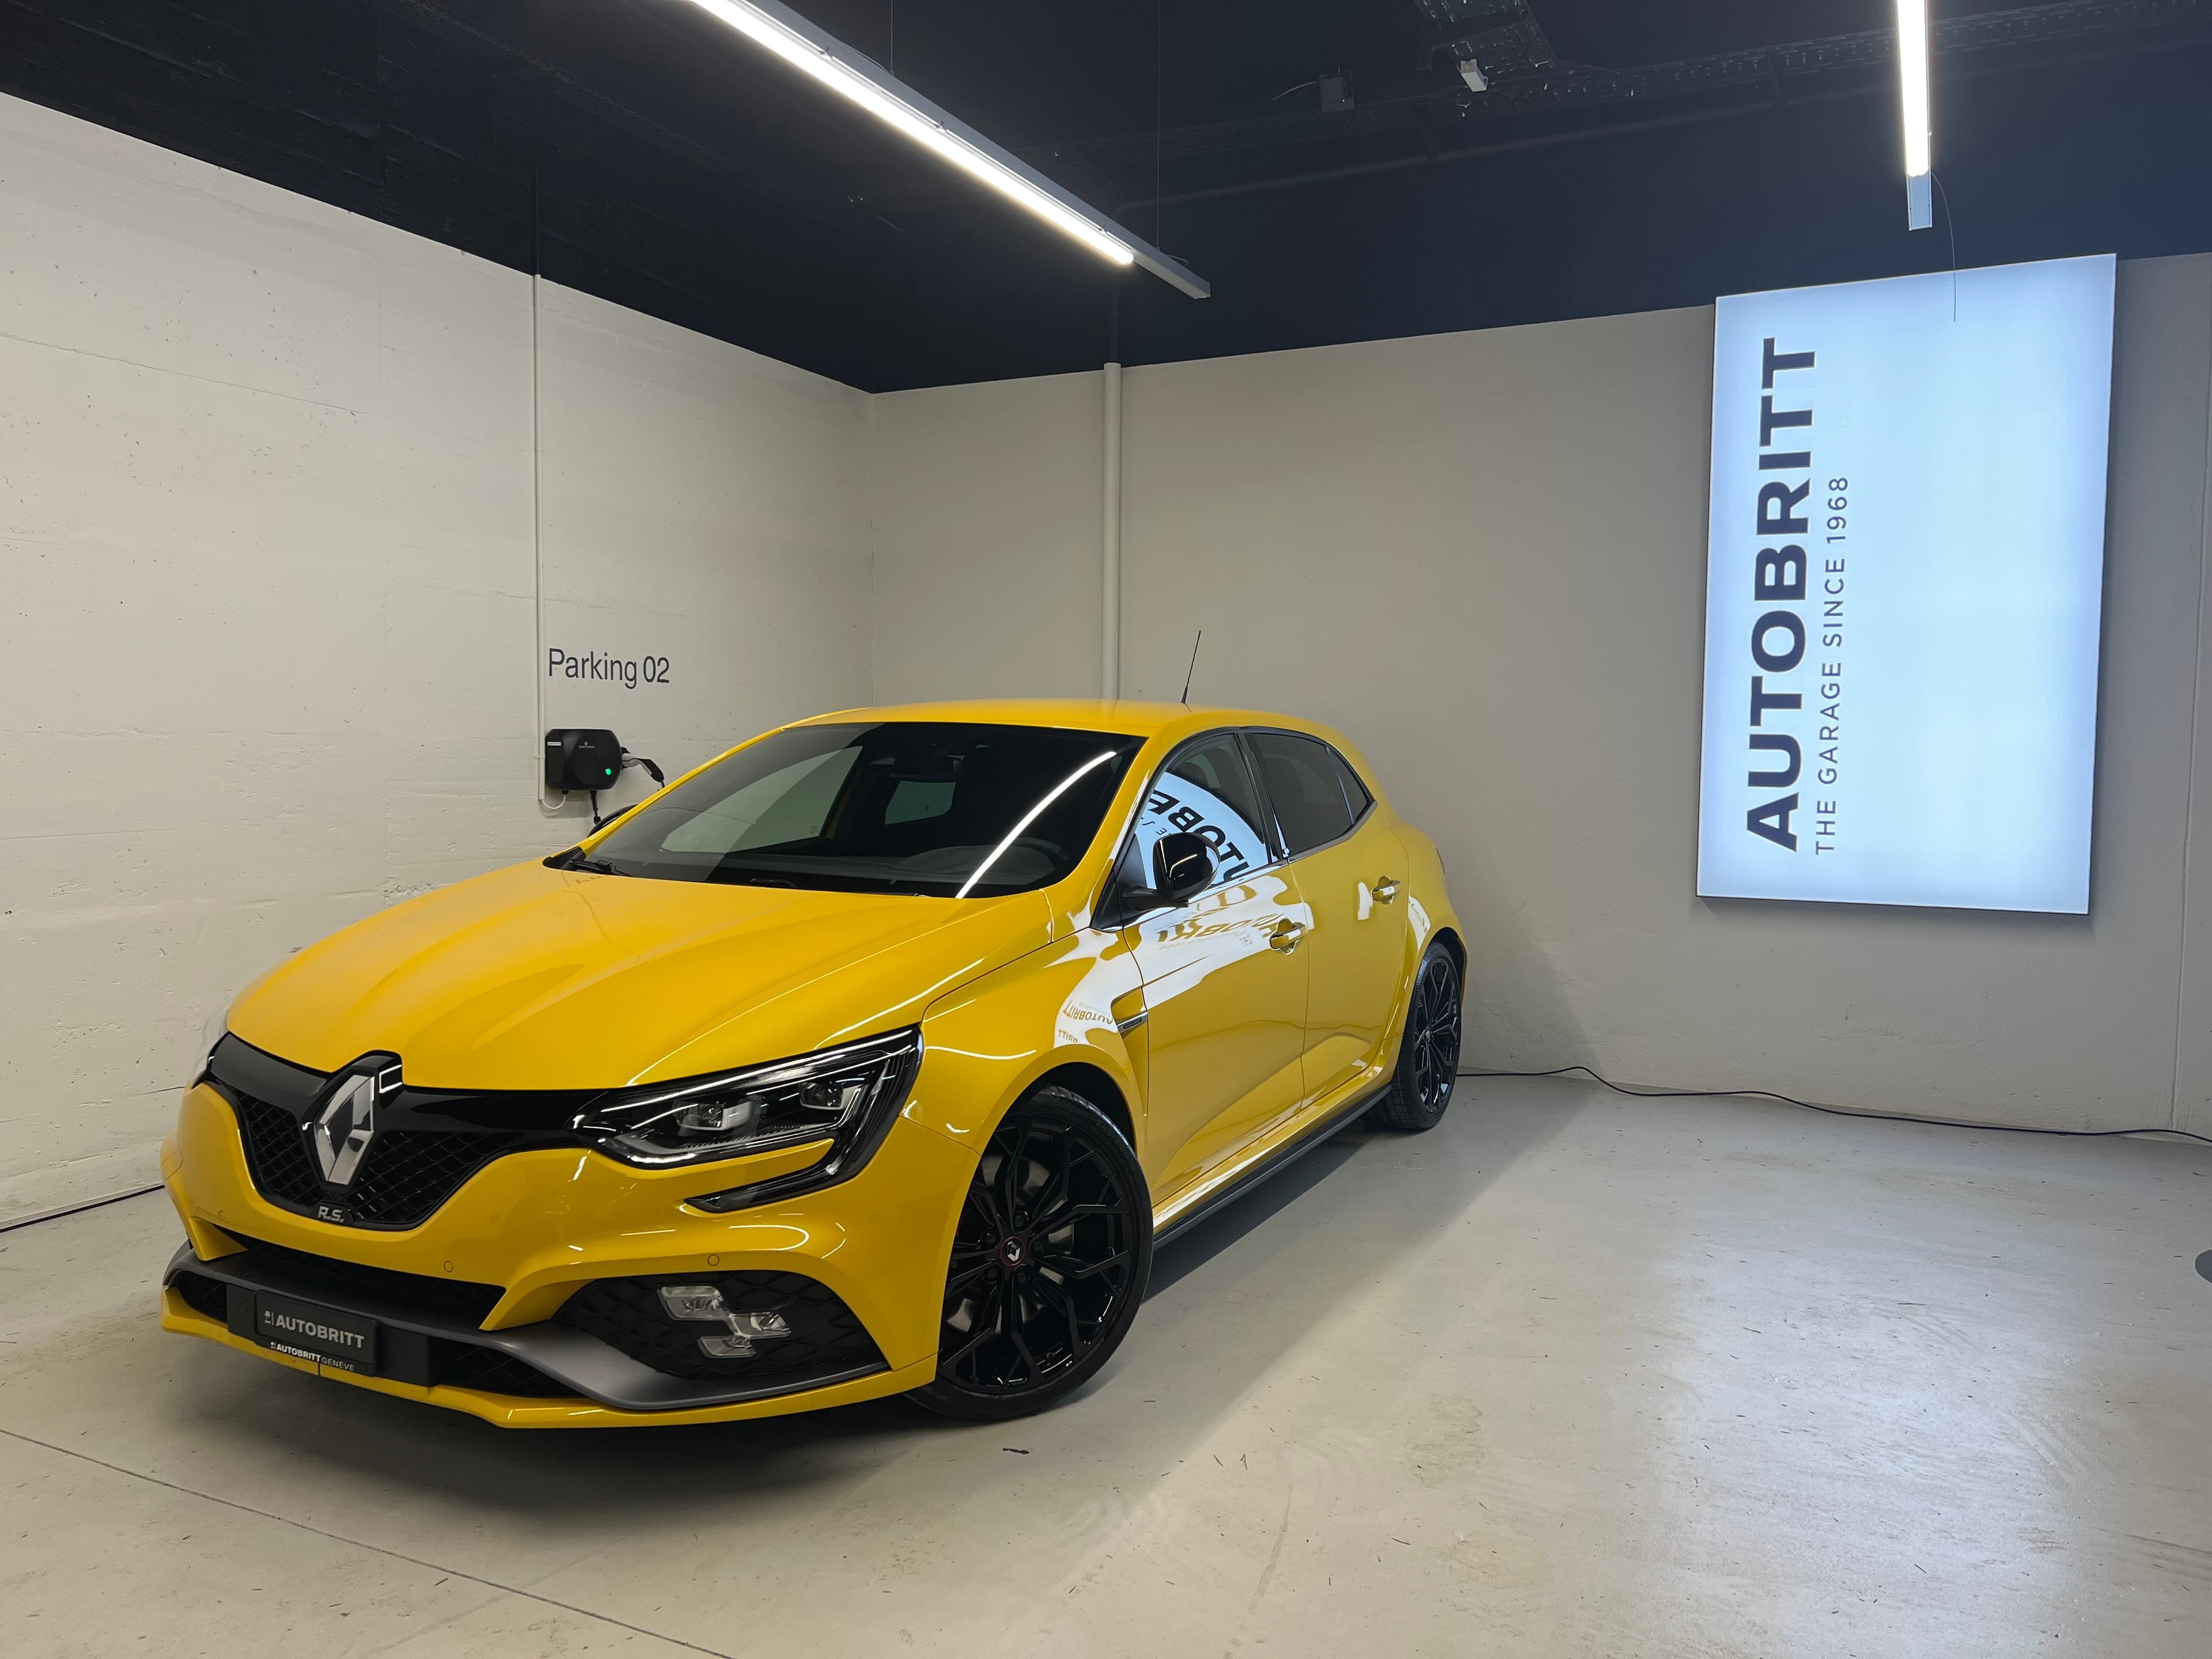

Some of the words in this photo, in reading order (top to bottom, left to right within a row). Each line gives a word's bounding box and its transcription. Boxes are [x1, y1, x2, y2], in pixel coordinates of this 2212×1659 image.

[1826, 477, 1849, 545] 1968
[1747, 336, 1816, 853] AUTOBRITT
[1822, 558, 1846, 648] SINCE
[548, 647, 638, 690] Parking
[642, 655, 671, 684] 02
[1817, 662, 1842, 785] GARAGE
[1815, 800, 1836, 855] THE
[275, 1314, 365, 1349] AUTOBRITT
[276, 1343, 321, 1362] AUTOBRITT
